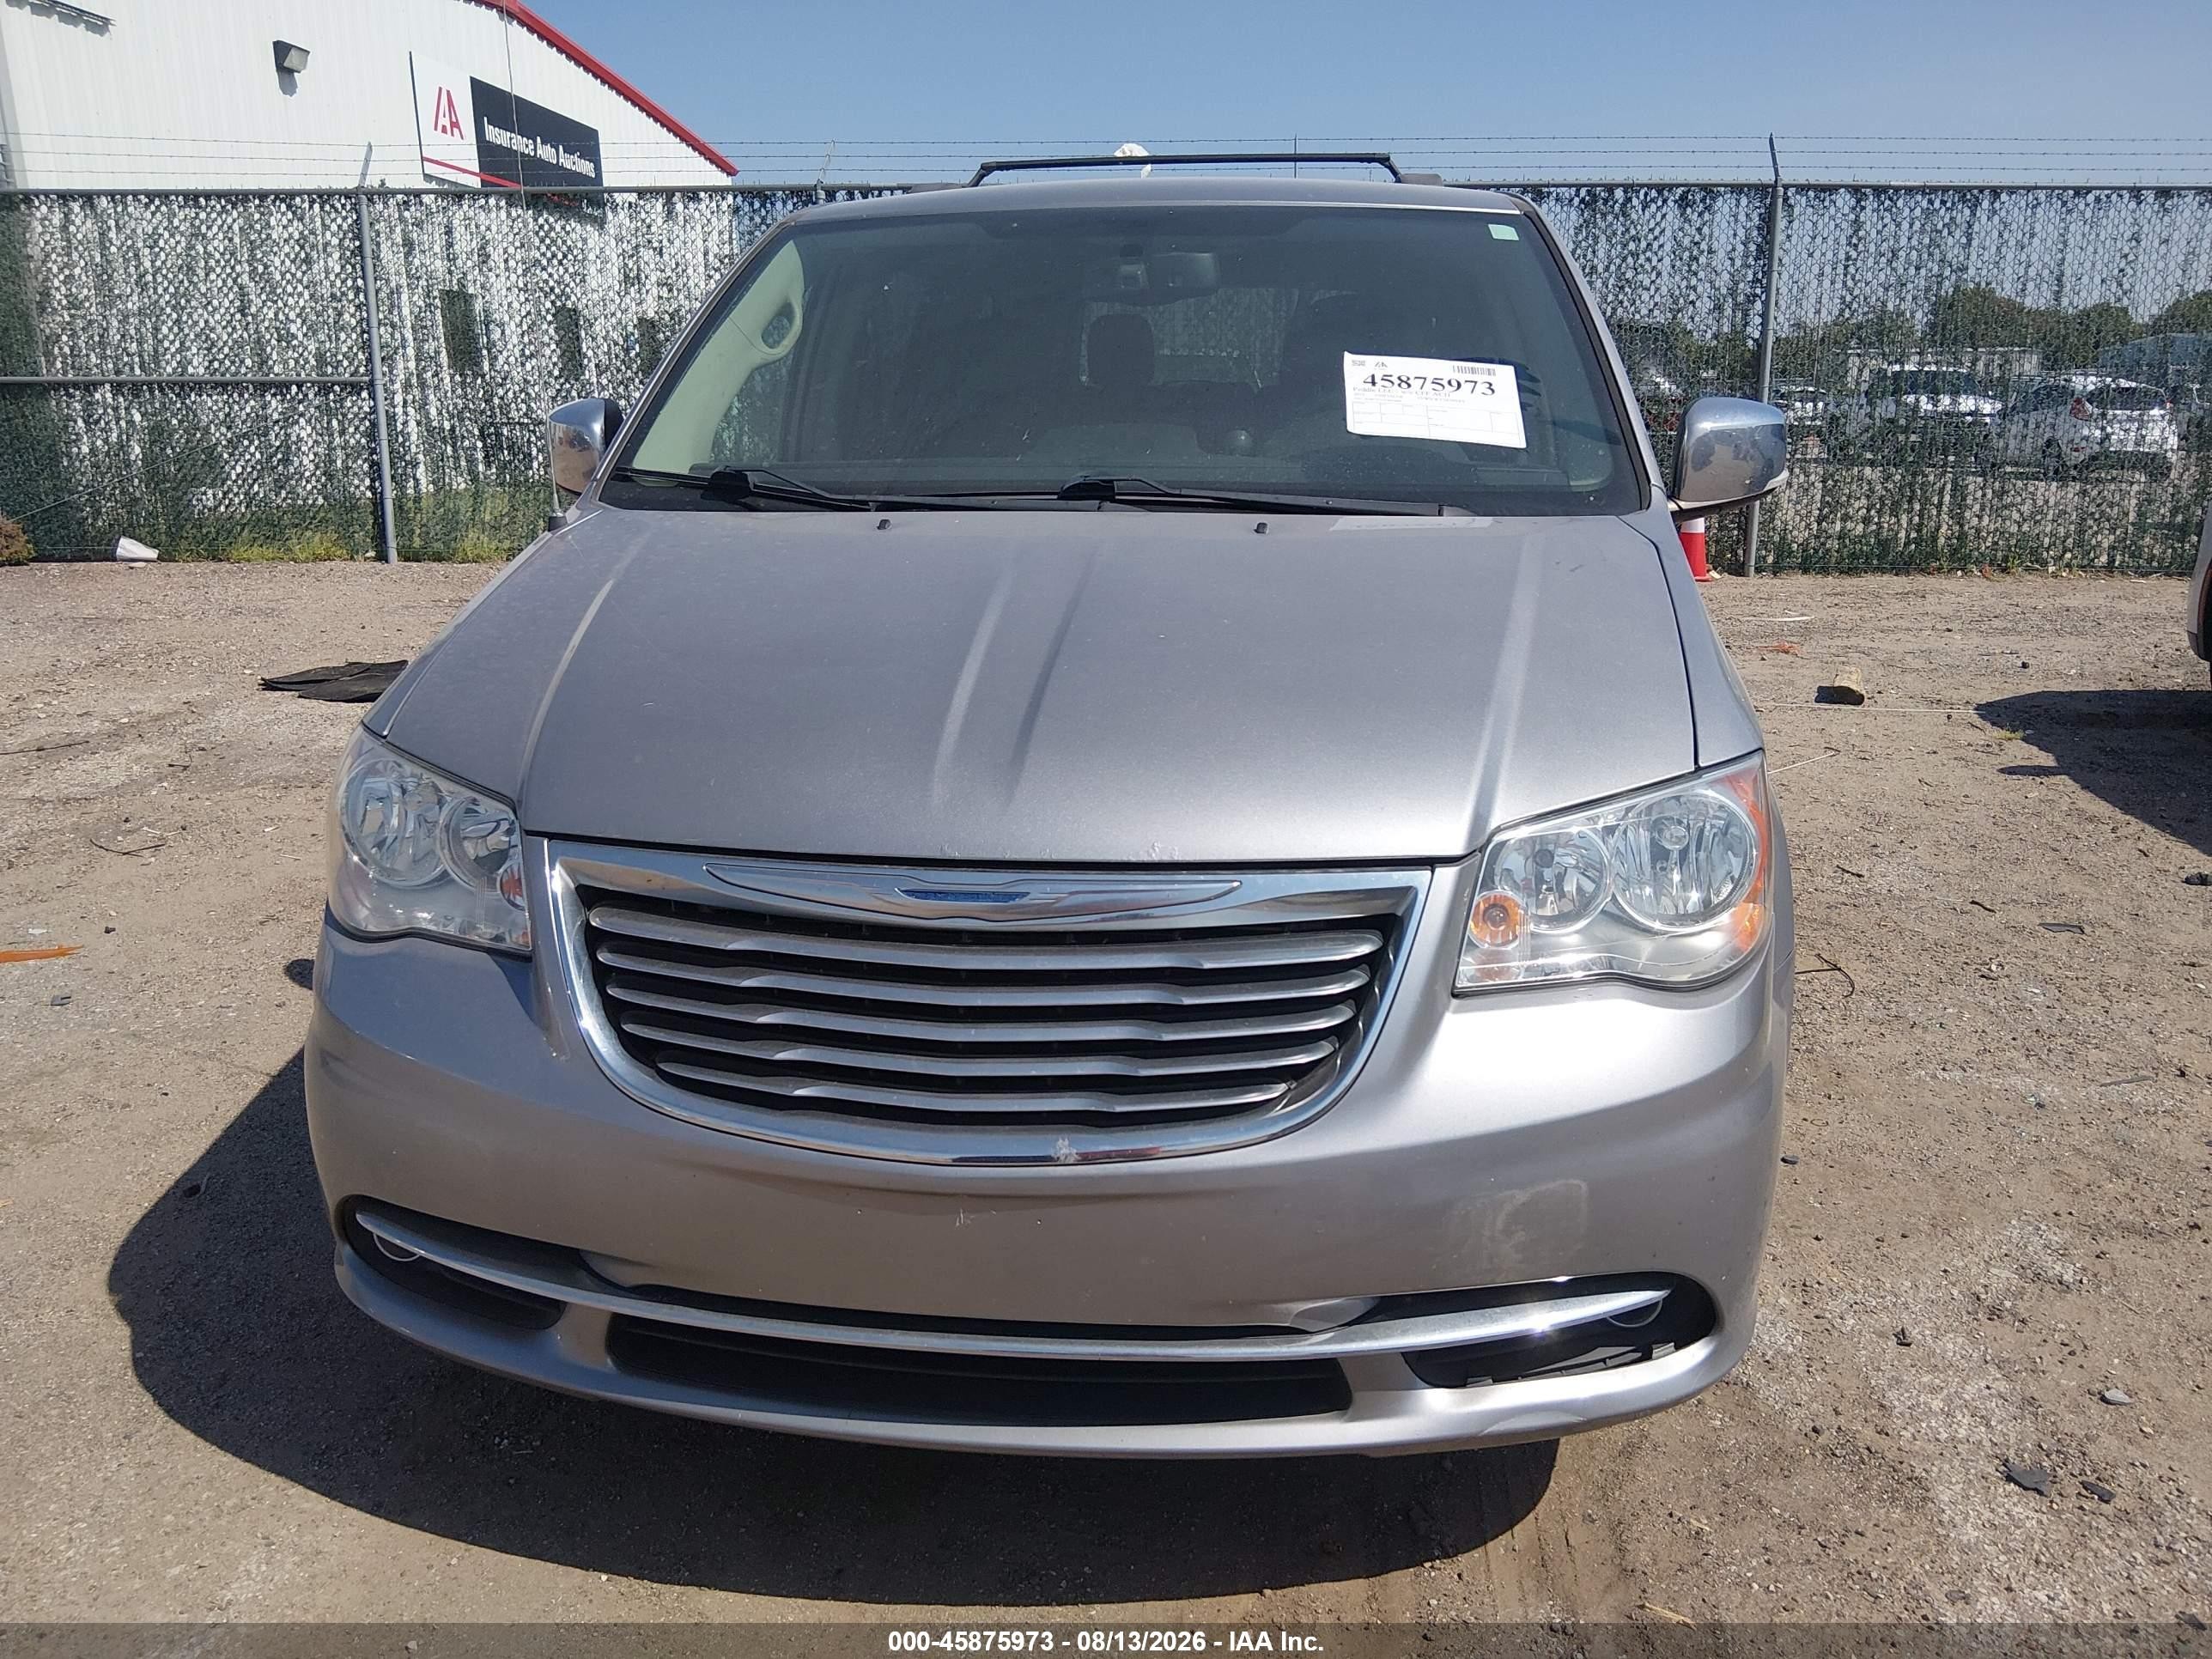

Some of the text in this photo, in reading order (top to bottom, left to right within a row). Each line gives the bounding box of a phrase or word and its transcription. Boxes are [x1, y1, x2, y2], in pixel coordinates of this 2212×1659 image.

[483, 116, 596, 179] Insurance Auto Auctions
[1363, 373, 1496, 396] 45875973
